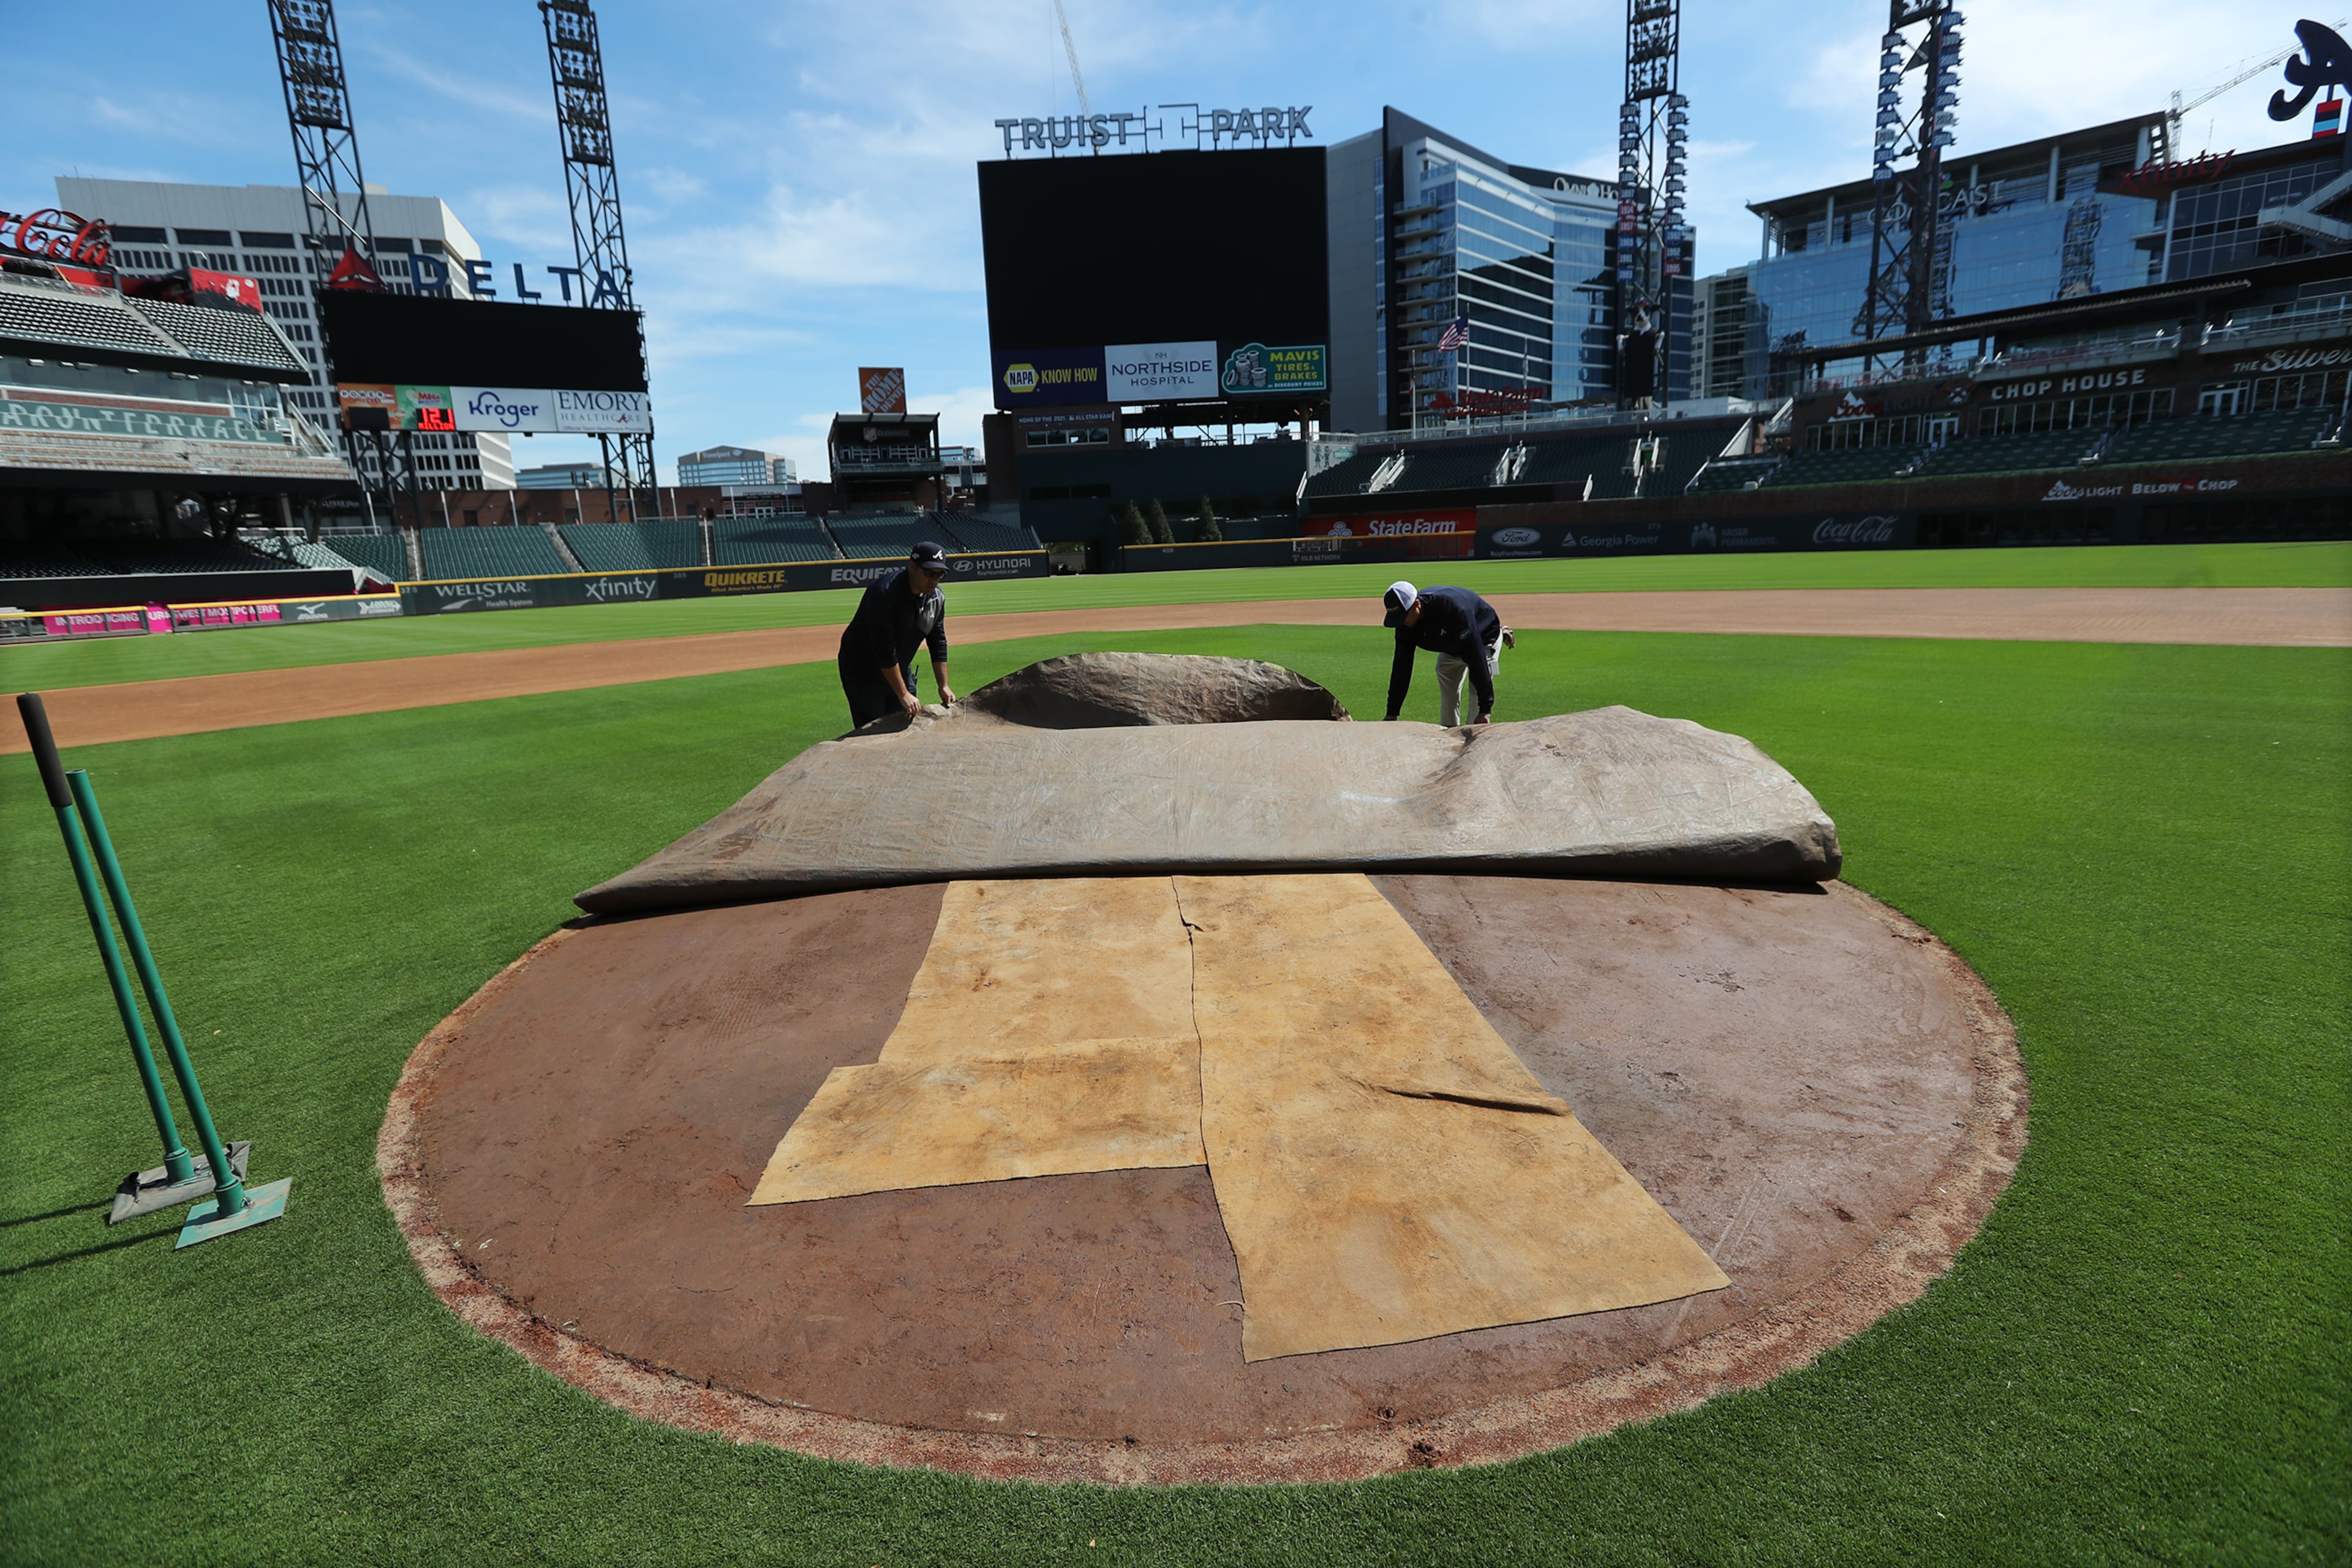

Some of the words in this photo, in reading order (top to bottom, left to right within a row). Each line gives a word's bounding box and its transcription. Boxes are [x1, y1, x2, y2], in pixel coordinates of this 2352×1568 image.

[995, 113, 1133, 149] TRUIST
[1212, 105, 1313, 140] PARK
[2118, 148, 2236, 193] xfinity
[1866, 179, 2006, 225] COCAST
[1620, 221, 1634, 231] 1957
[1666, 247, 1681, 257] 1992
[1666, 263, 1681, 273] 1995
[408, 253, 628, 311] DELTA
[1270, 350, 1320, 362] MAVIS
[1112, 360, 1212, 375] NORTHSIDE
[1276, 363, 1310, 372] TIRES
[2233, 360, 2260, 373] THE
[864, 372, 882, 391] THE
[1009, 371, 1035, 385] NAPA
[1041, 369, 1072, 384] KNOW
[1074, 367, 1098, 383] HOW
[1131, 376, 1194, 386] HOSPITAL
[1275, 371, 1318, 380] BRAKES
[862, 368, 903, 412] HOME
[1991, 380, 2052, 400] CHOP
[2061, 369, 2146, 393] HOUSE
[339, 390, 385, 399] POWER
[559, 392, 642, 412] EMORY
[879, 384, 904, 412] DEPOT
[469, 391, 538, 427] Kroger
[1832, 400, 1884, 419] Coors
[1884, 396, 1931, 413] LIGHT
[562, 413, 643, 423] HEALTHCARE
[2047, 484, 2084, 498] Coors
[2085, 485, 2124, 497] LIGHT
[2196, 478, 2239, 491] CHOP
[1501, 530, 1531, 543] Ford
[1812, 516, 1900, 543] Coca-Cola
[1580, 534, 1623, 548] Georgia
[1624, 533, 1660, 545] Power
[976, 558, 1031, 570] HYUNDAI
[704, 570, 786, 587] QUIKRETE
[434, 582, 527, 598] WELLSTAR
[584, 577, 656, 601] xfinity
[509, 599, 533, 608] System
